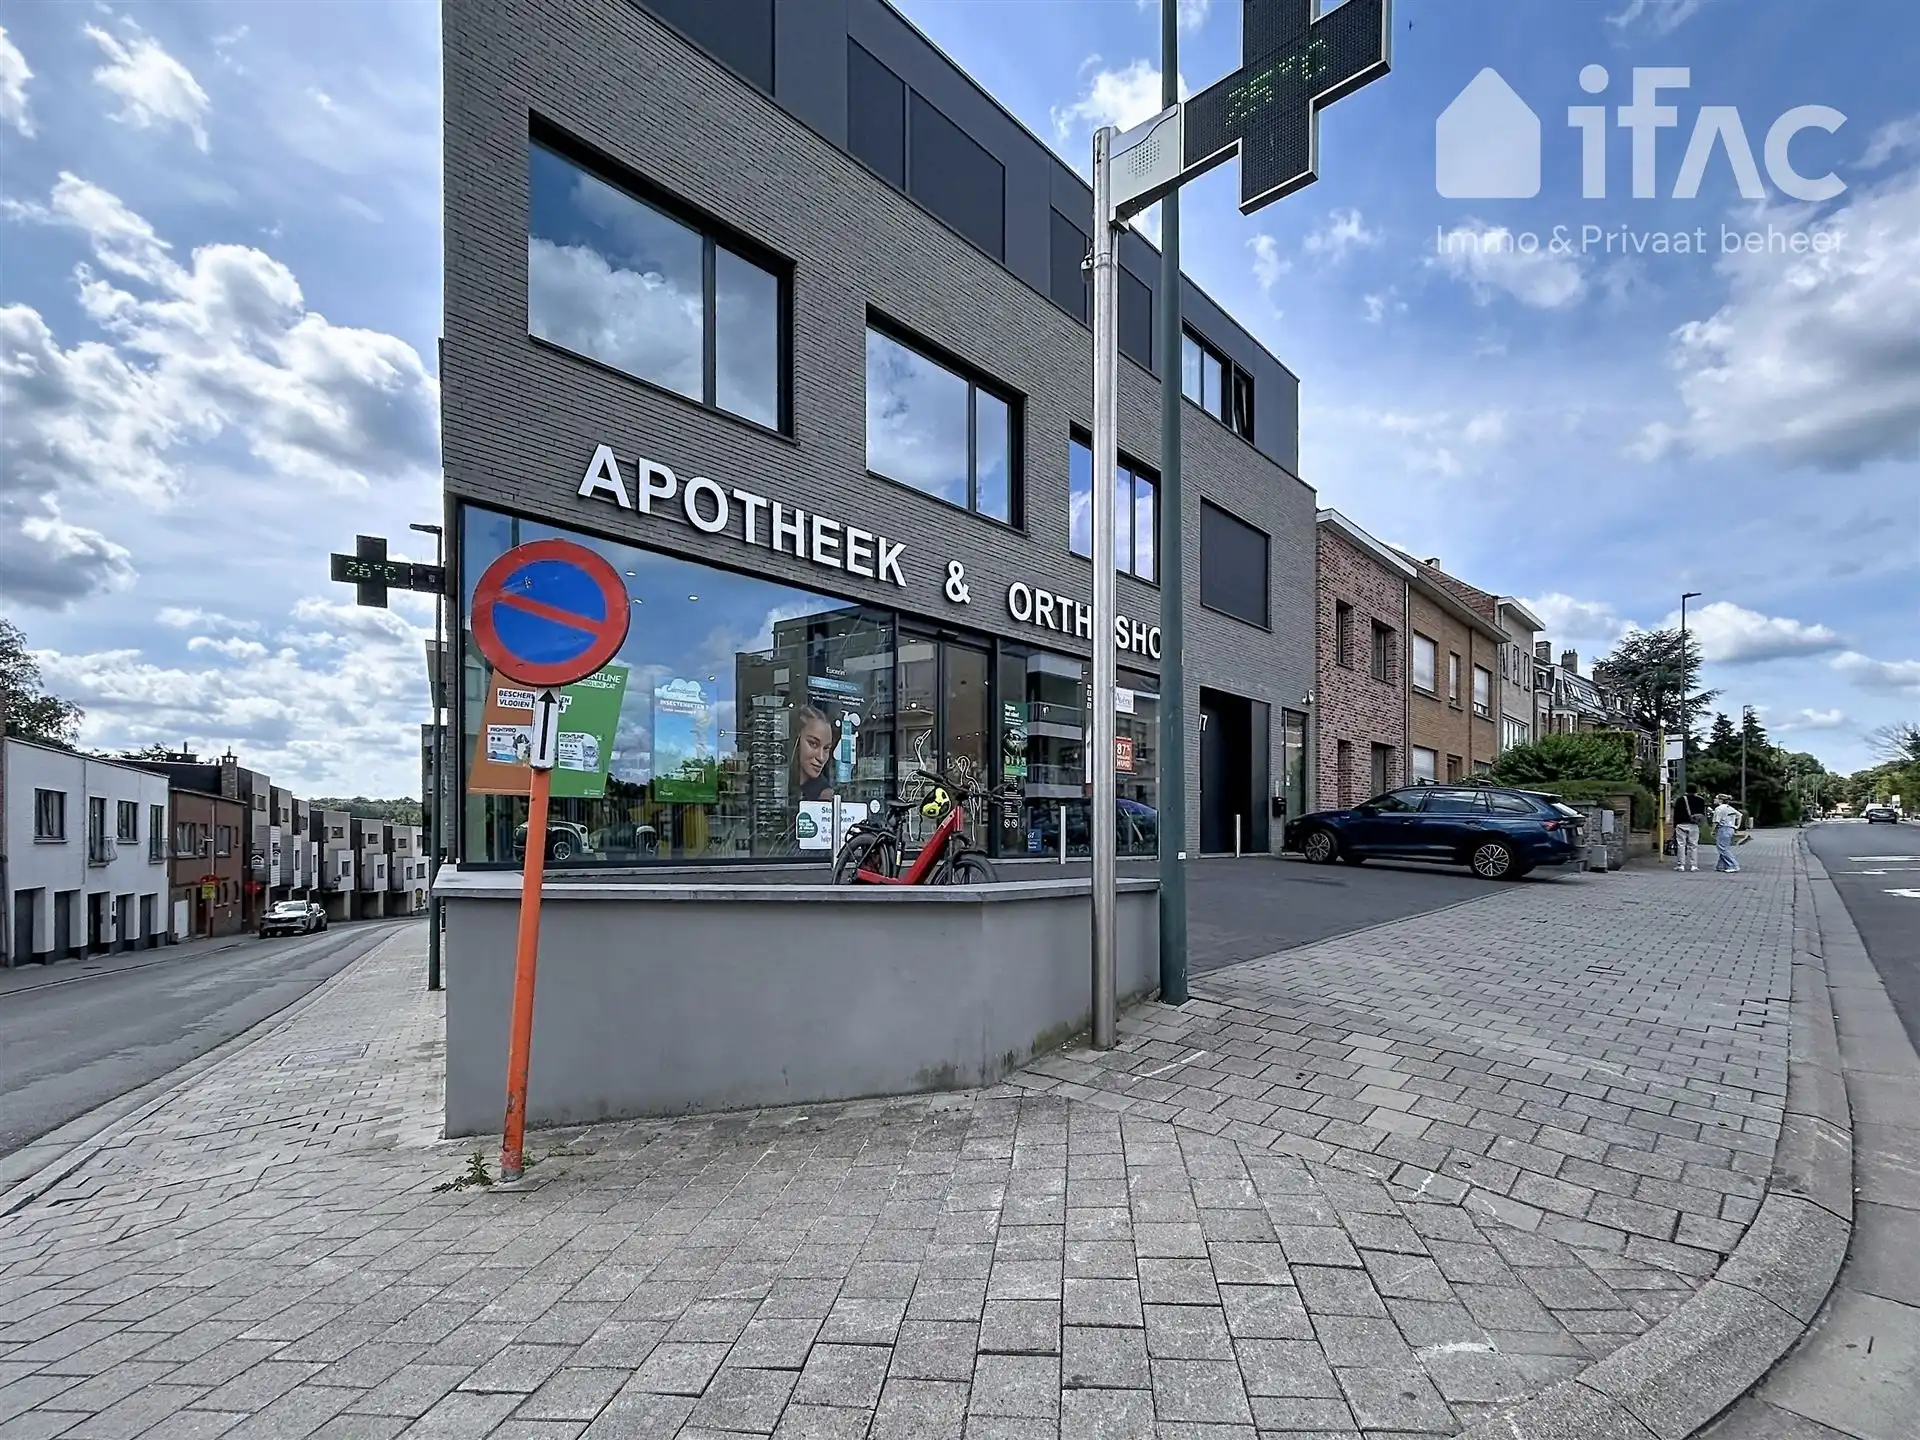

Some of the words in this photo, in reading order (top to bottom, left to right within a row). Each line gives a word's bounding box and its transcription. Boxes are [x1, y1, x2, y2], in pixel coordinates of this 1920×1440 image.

[577, 443, 907, 588] APOTHEEK
[945, 560, 971, 604] &
[499, 699, 530, 708] VLOOIEN
